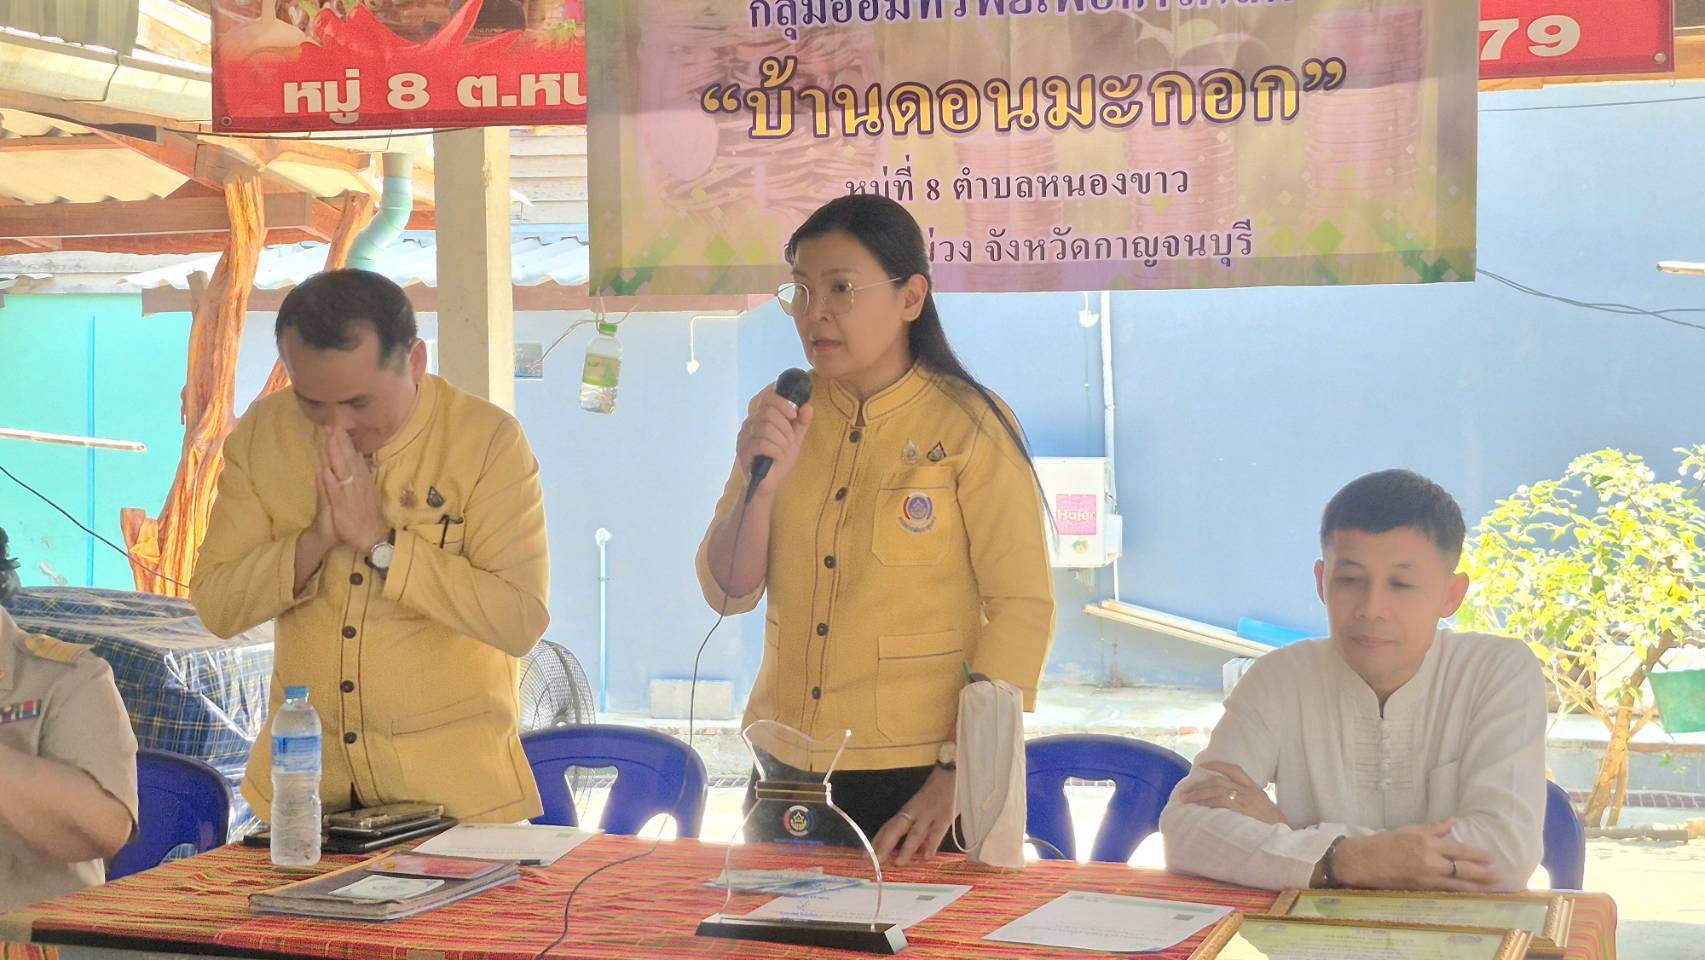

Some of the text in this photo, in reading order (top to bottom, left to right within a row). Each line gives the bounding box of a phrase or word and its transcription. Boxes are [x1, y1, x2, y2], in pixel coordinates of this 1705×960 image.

[1479, 14, 1582, 61] 79
[283, 68, 361, 124] หมู่
[386, 72, 431, 110] 8
[701, 56, 1347, 139] “บ้านดอนมะกอก”
[926, 178, 940, 201] 8
[953, 166, 1189, 200] ตำบลหนองขาว
[984, 218, 1253, 268] จังหวัดกาญจนบุรี
